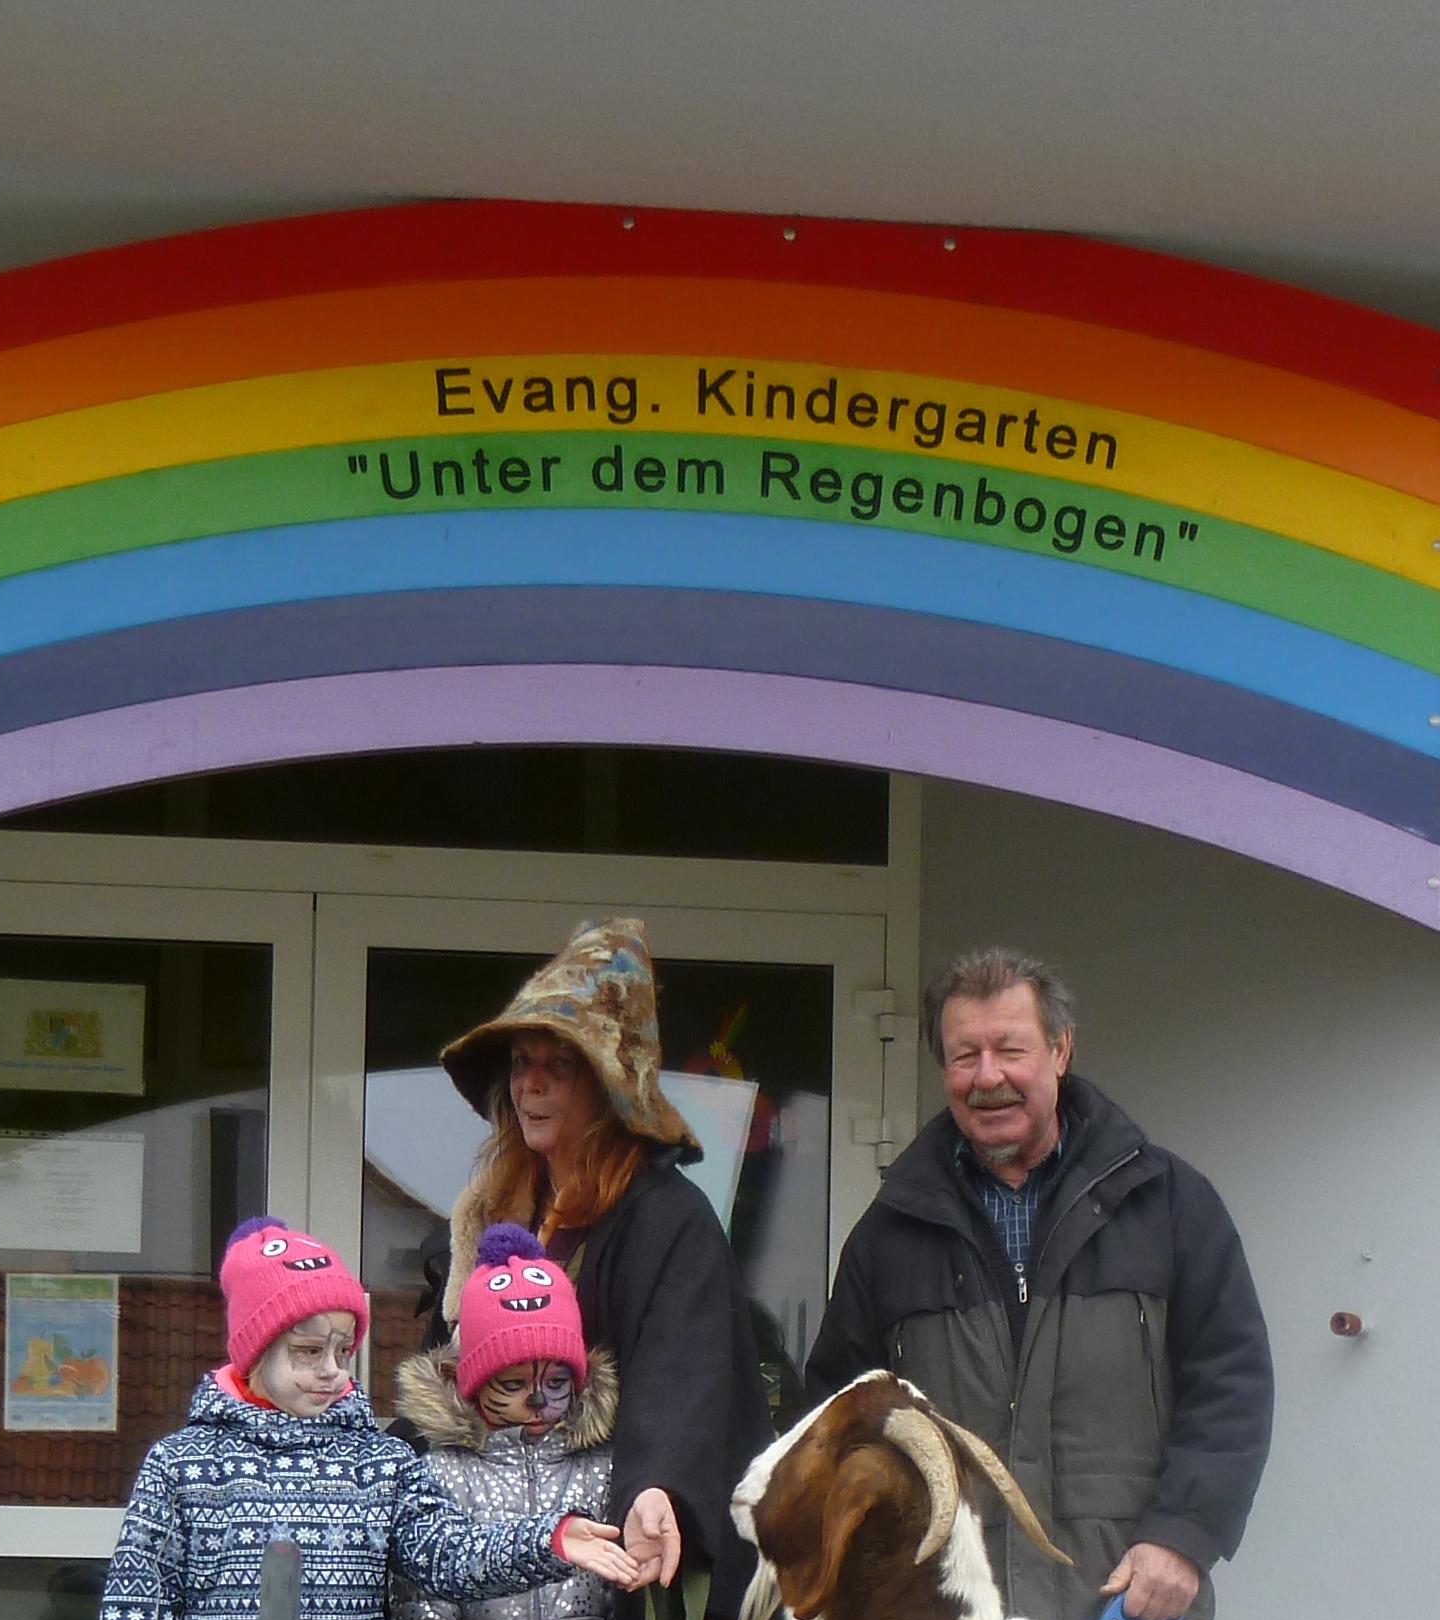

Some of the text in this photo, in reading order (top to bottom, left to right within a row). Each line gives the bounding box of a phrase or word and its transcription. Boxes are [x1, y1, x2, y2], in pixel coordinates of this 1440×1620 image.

[434, 367, 1118, 469] Evang. Kindergarten
[347, 445, 1199, 561] "Unter dem Regenbogen"
